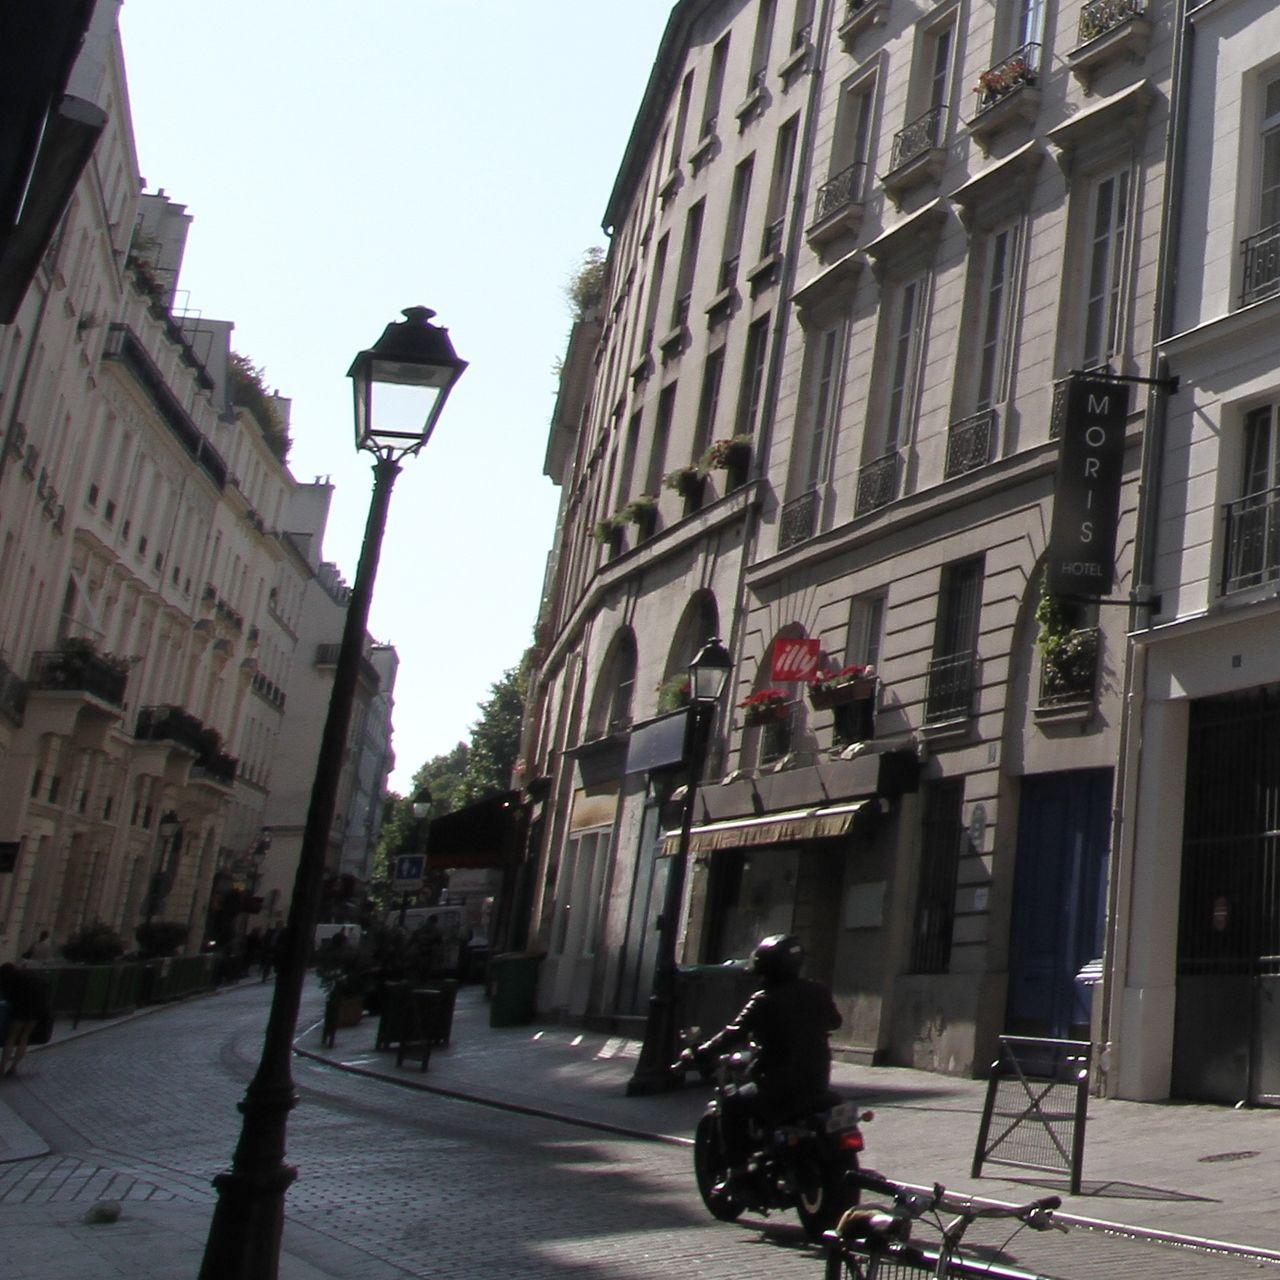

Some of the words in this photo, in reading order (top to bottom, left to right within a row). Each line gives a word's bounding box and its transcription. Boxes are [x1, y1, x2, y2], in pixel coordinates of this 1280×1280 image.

[1080, 393, 1110, 543] MORIS
[1061, 561, 1104, 577] HOTEL
[775, 644, 817, 678] illy
